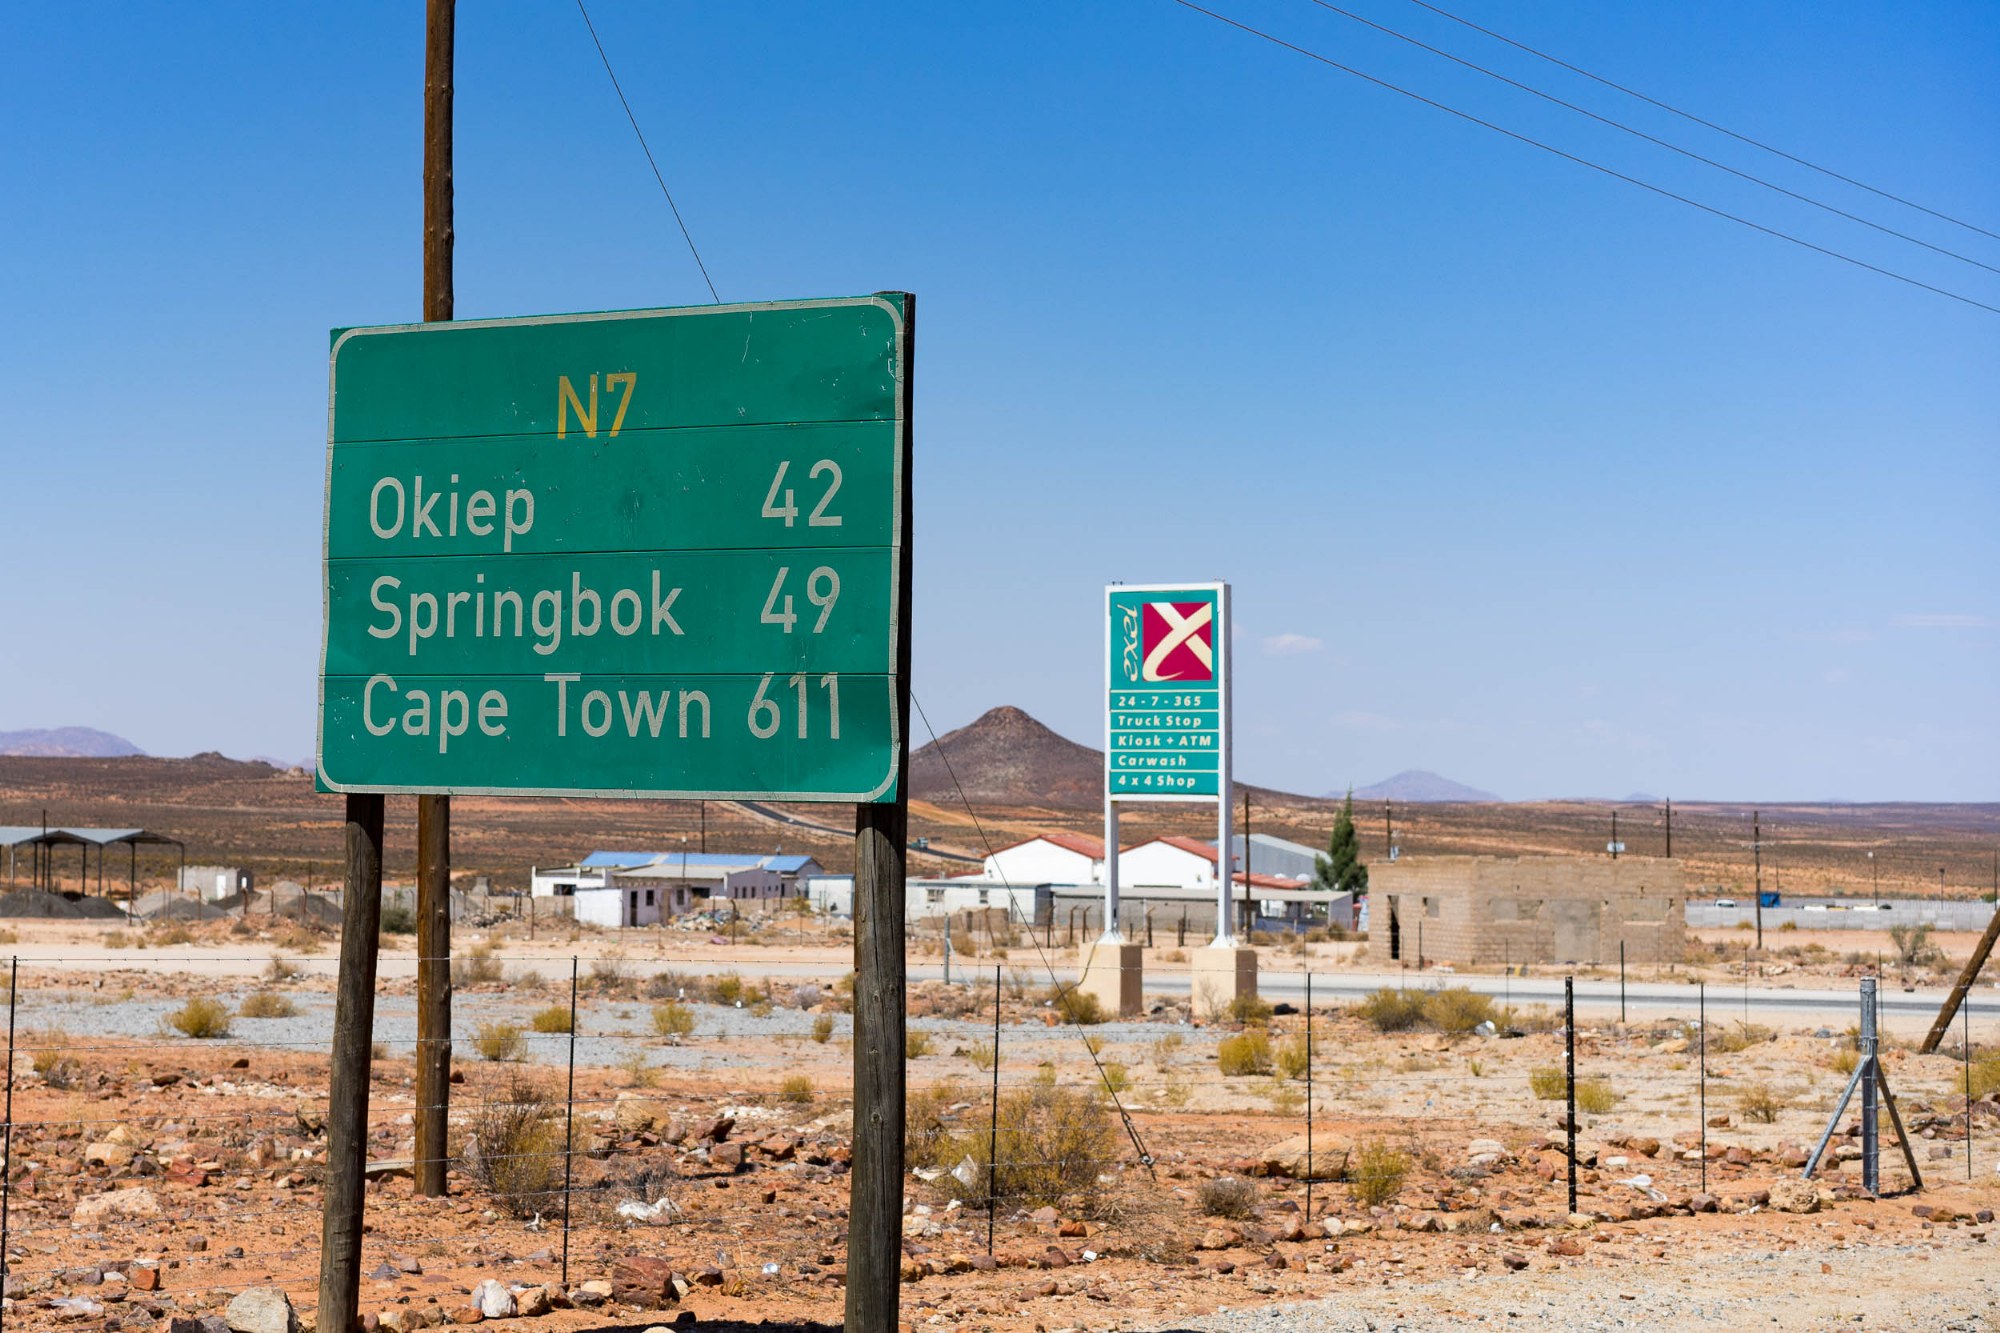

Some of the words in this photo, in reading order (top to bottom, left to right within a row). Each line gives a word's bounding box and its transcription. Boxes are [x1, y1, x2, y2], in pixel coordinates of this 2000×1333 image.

[557, 372, 636, 439] N7
[370, 474, 534, 553] Okiep
[761, 459, 842, 527] 42
[367, 570, 684, 656] Springbok
[760, 566, 840, 633] 49
[363, 673, 508, 754] Cape
[544, 672, 711, 738] Town
[748, 671, 839, 739] 611
[1118, 715, 1161, 726] Truck
[1166, 715, 1202, 728] Stop
[1118, 735, 1161, 746] Kiosk
[1179, 735, 1211, 746] ATM
[1118, 755, 1187, 766] Carwash
[1157, 774, 1196, 788] Shop
